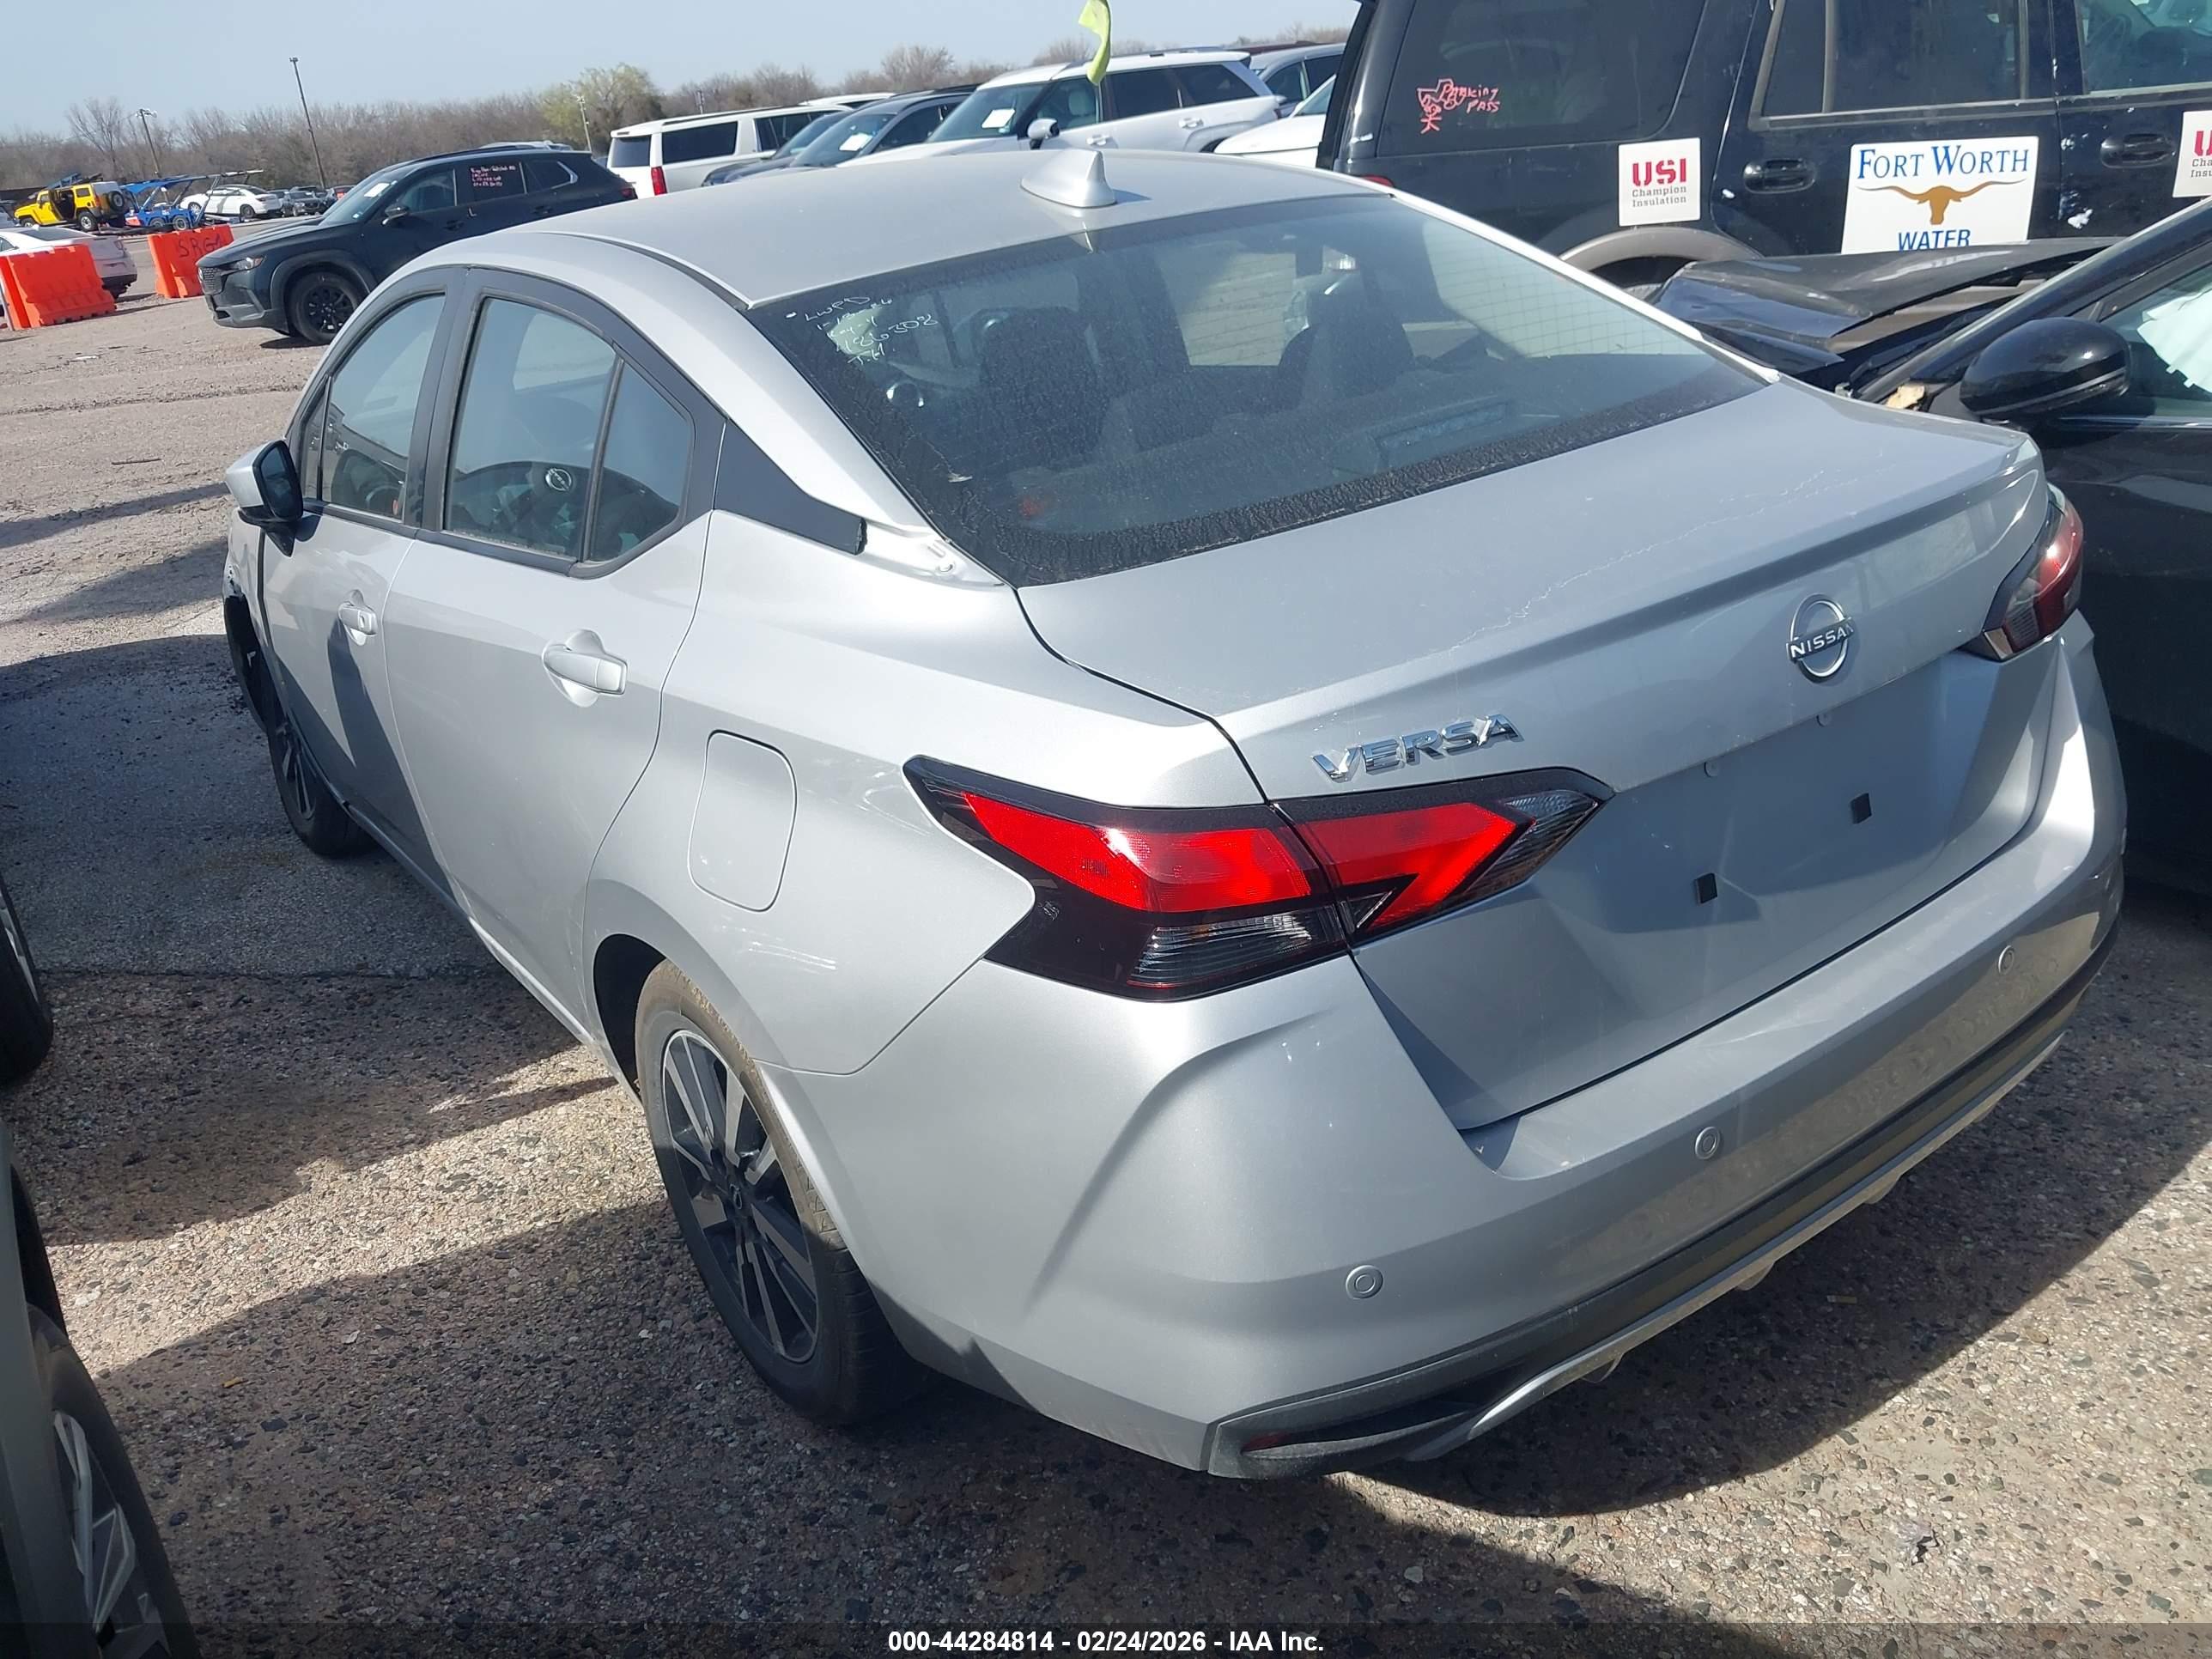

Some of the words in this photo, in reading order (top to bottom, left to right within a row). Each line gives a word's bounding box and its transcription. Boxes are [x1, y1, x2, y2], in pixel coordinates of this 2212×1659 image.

[1466, 99, 1500, 114] PASS
[1632, 158, 1686, 186] USI
[1857, 149, 1924, 179] FORT
[1932, 144, 2029, 176] WORTH
[1632, 186, 1687, 198] Champion
[1632, 196, 1687, 207] Insulation
[1790, 623, 1855, 659] NISSAN
[1310, 714, 1522, 782] VERSA
